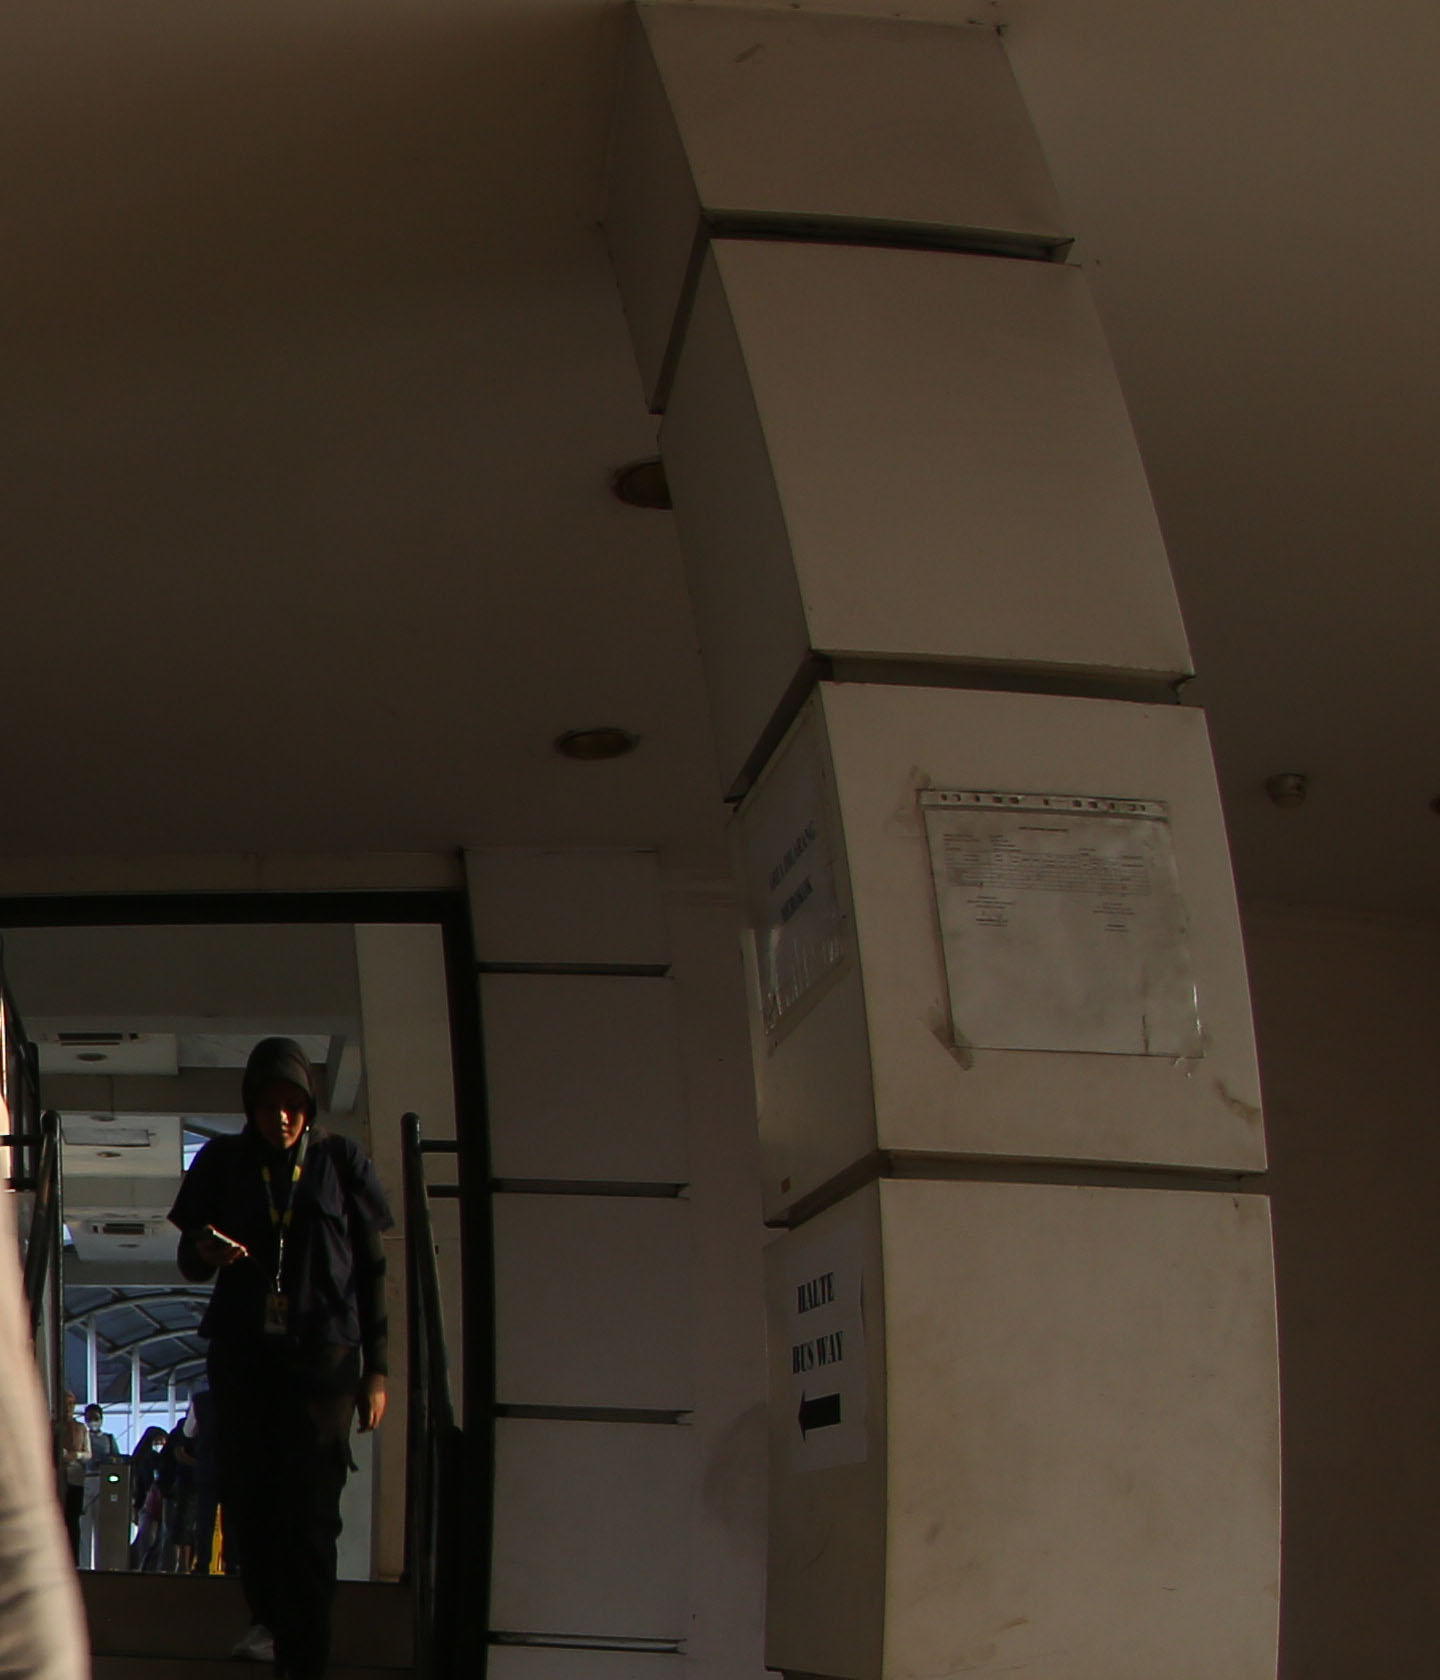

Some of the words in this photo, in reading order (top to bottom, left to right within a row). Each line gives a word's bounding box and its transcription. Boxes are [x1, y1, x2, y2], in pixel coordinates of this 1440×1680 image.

[797, 1272, 834, 1314] HALTE
[792, 1341, 814, 1374] BUS
[816, 1330, 843, 1367] WAY
